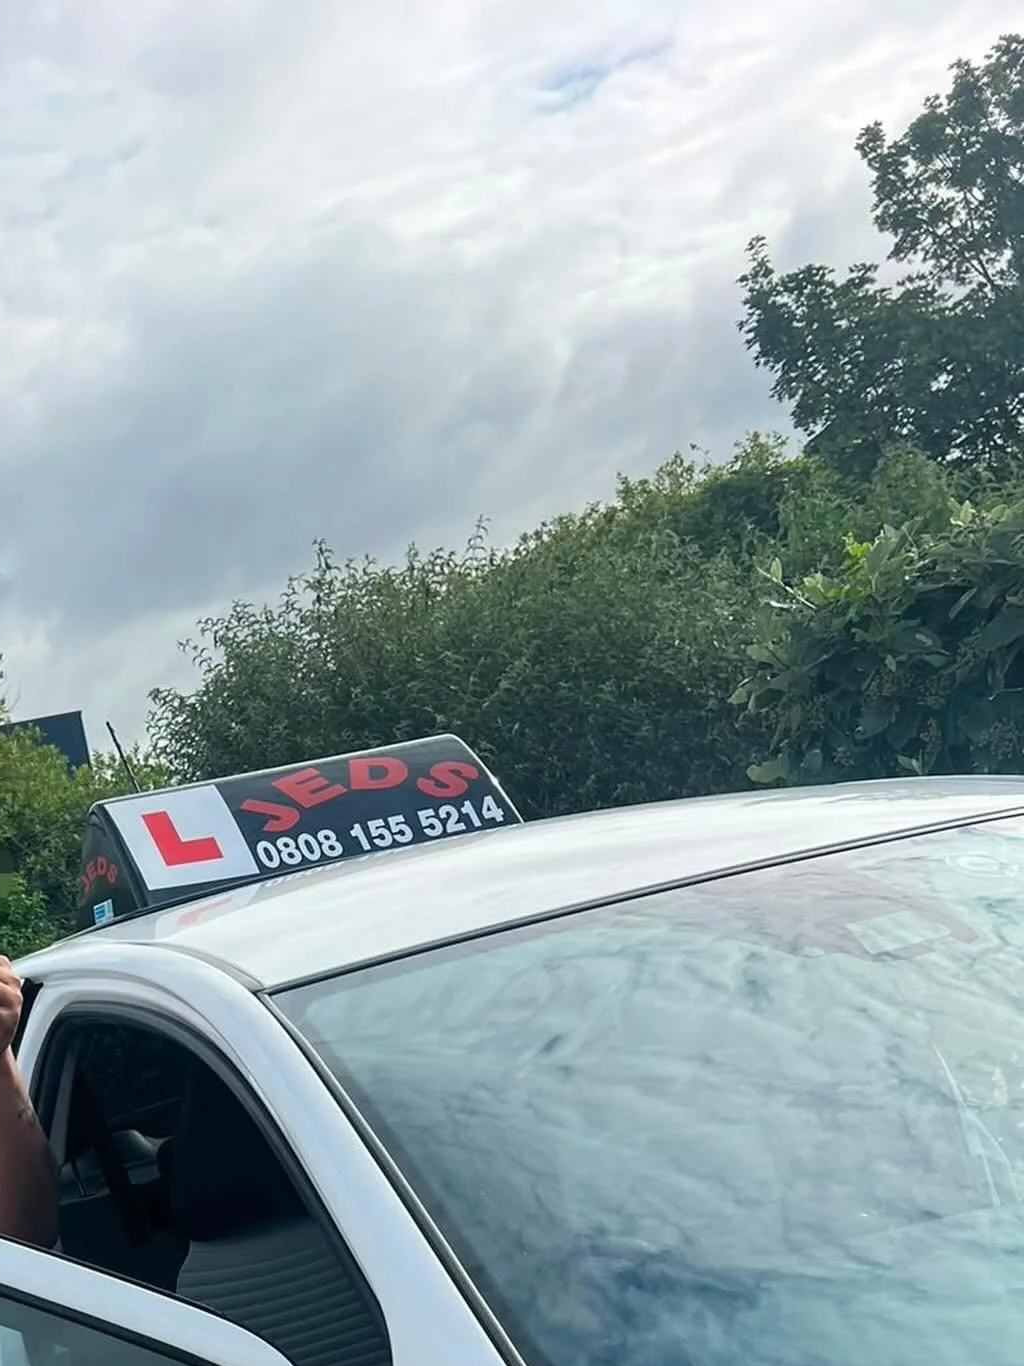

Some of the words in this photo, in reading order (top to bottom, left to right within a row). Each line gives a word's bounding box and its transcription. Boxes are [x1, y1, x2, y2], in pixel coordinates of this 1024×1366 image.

[240, 757, 479, 832] JEDS
[141, 810, 224, 867] L
[256, 829, 344, 870] 0808
[351, 814, 414, 852] 155
[416, 795, 504, 840] 5214
